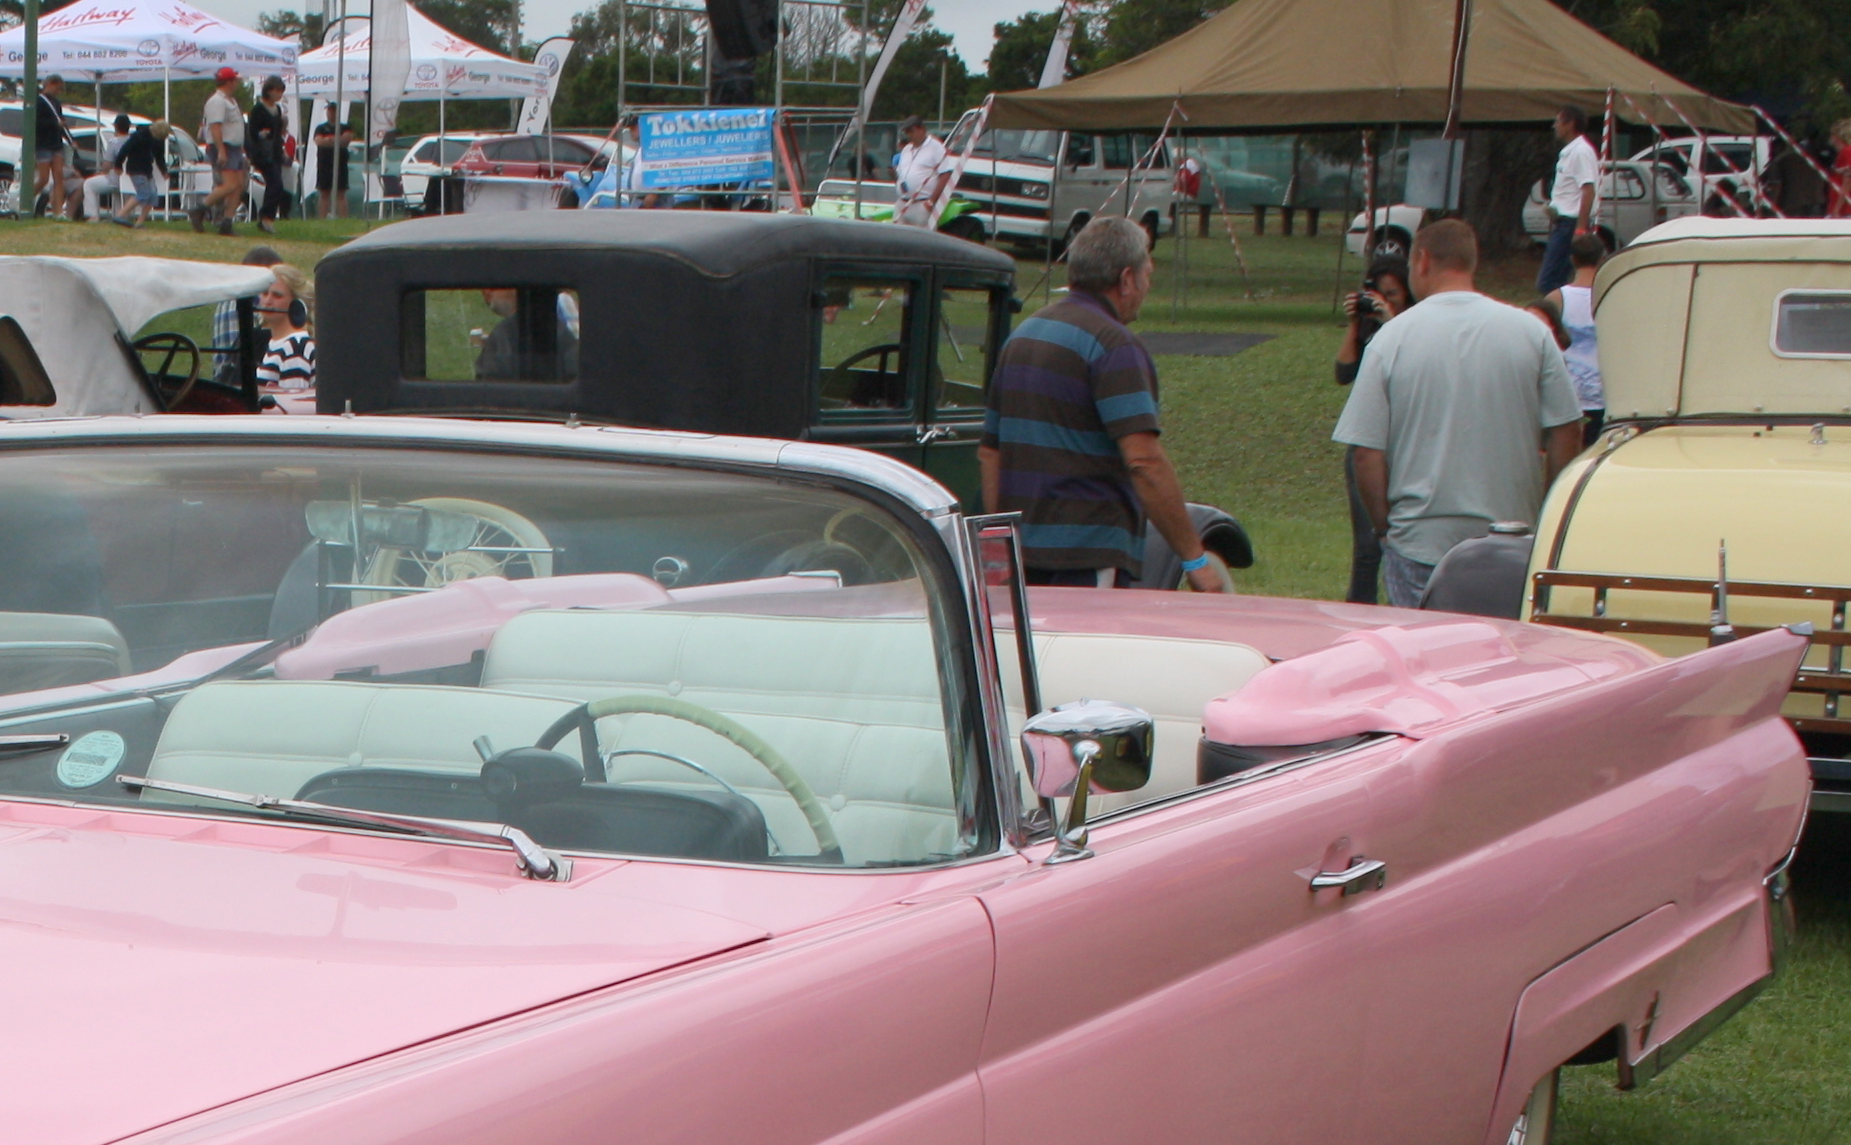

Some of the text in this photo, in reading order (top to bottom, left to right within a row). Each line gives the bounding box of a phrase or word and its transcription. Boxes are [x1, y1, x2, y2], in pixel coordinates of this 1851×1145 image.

[40, 7, 136, 32] Halfway
[8, 51, 48, 65] Gege
[298, 73, 335, 86] George
[648, 136, 706, 149] JEWELLERS
